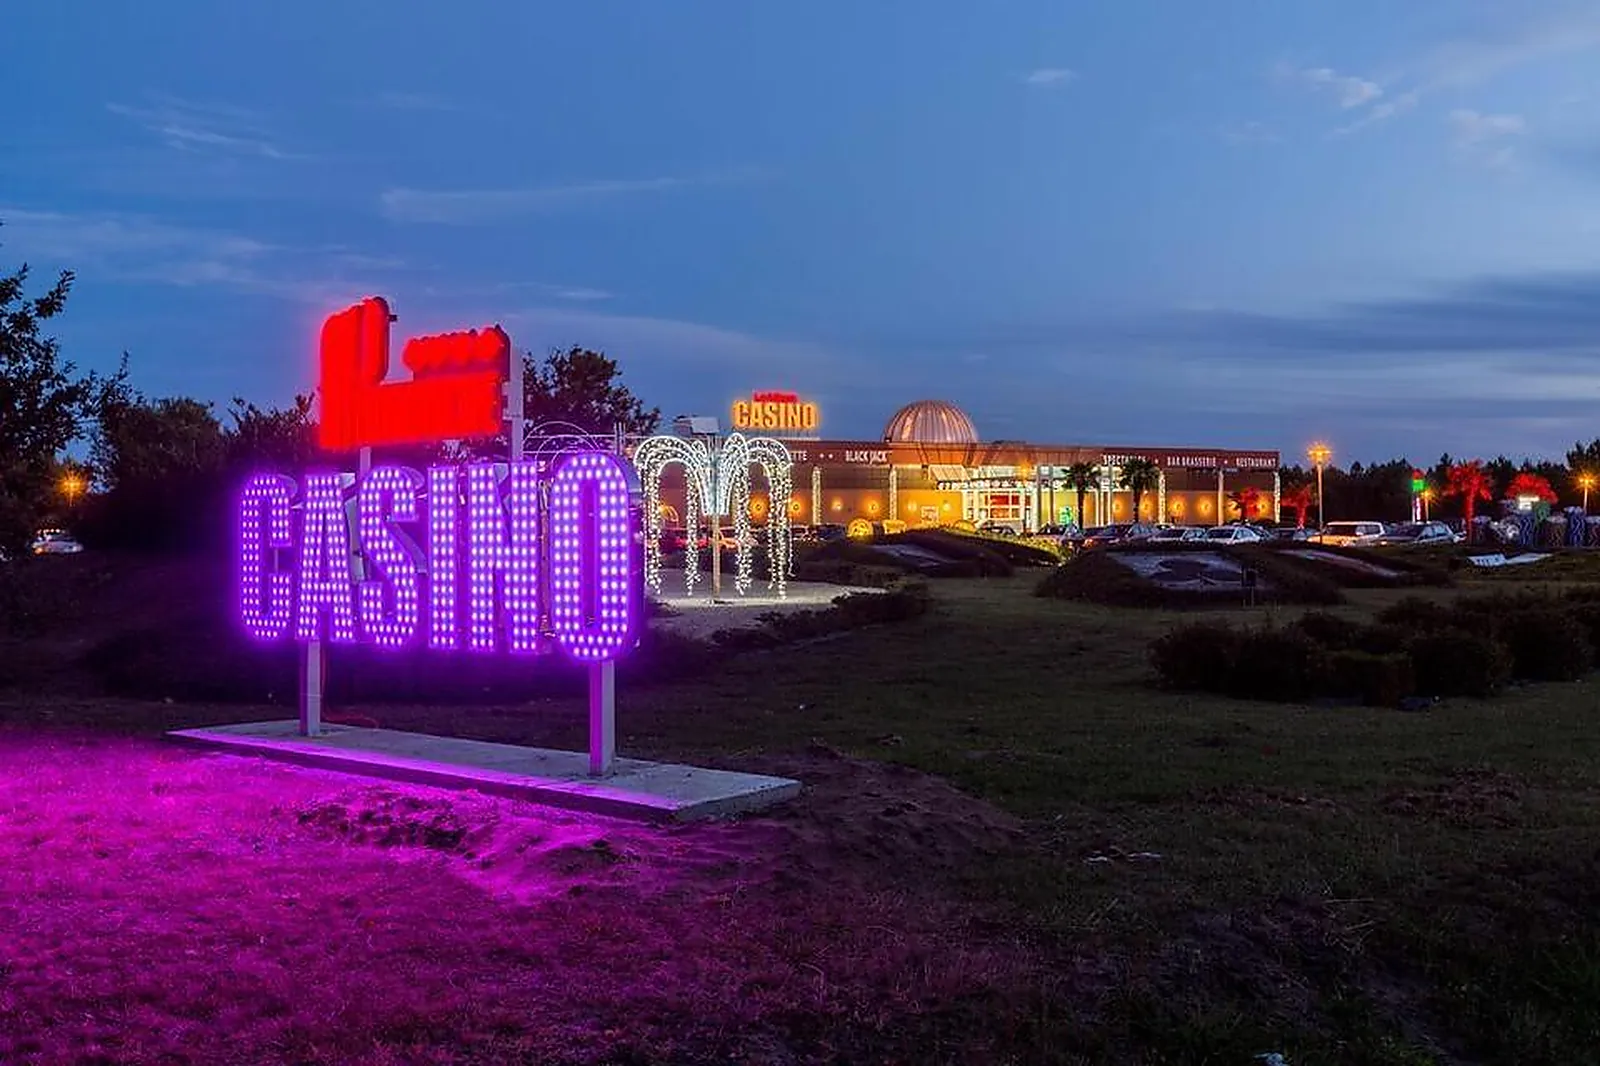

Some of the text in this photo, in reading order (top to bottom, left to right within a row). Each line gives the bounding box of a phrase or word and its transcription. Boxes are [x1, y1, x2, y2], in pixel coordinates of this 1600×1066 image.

[733, 401, 817, 428] CASINO
[845, 450, 868, 462] BLACK
[1167, 456, 1181, 467] BAR
[1236, 457, 1277, 468] RESTAURANT
[241, 453, 634, 660] CASINO
